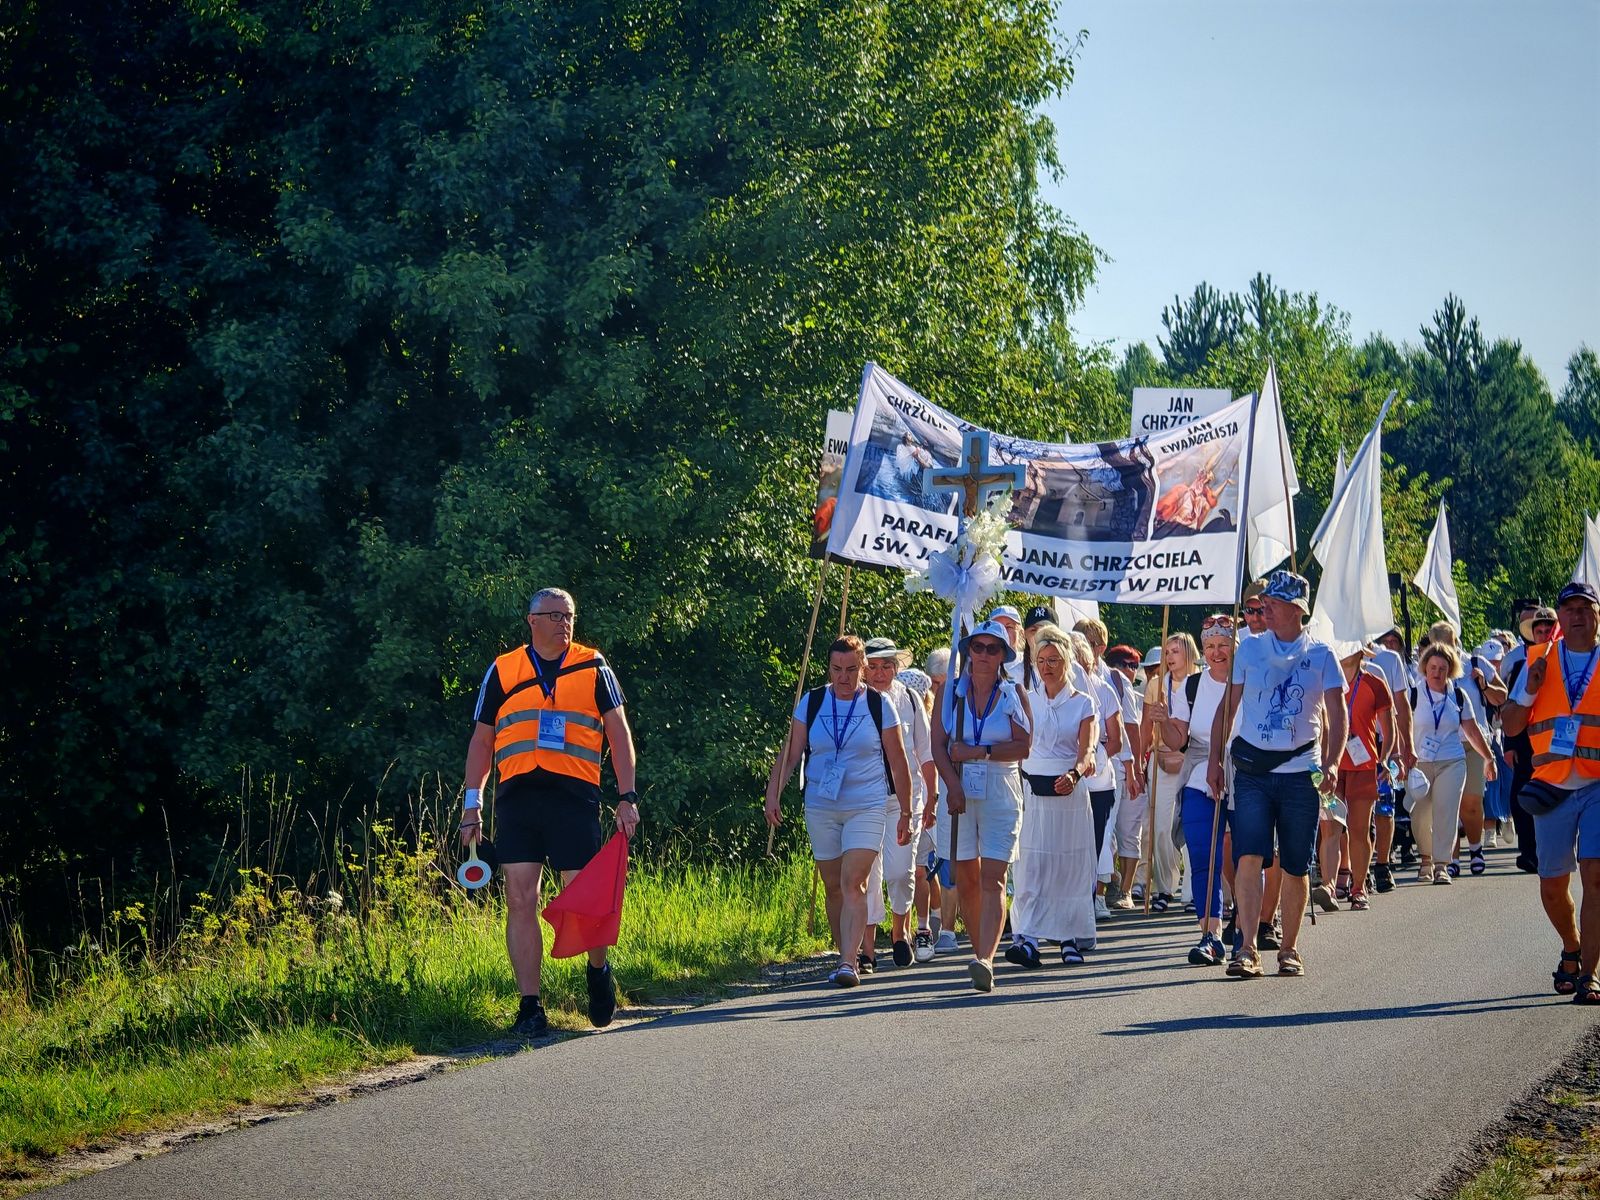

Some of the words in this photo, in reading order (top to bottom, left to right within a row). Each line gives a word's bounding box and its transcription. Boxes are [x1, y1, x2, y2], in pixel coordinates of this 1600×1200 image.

[1167, 396, 1194, 413] JAN
[828, 438, 848, 456] EWA
[872, 532, 910, 558] ŚW.
[1016, 547, 1074, 570] JANA
[1080, 549, 1203, 572] CHRZCICIELA
[999, 565, 1121, 593] WANGELISTY
[1128, 576, 1151, 592] W
[1155, 573, 1215, 593] PILICY
